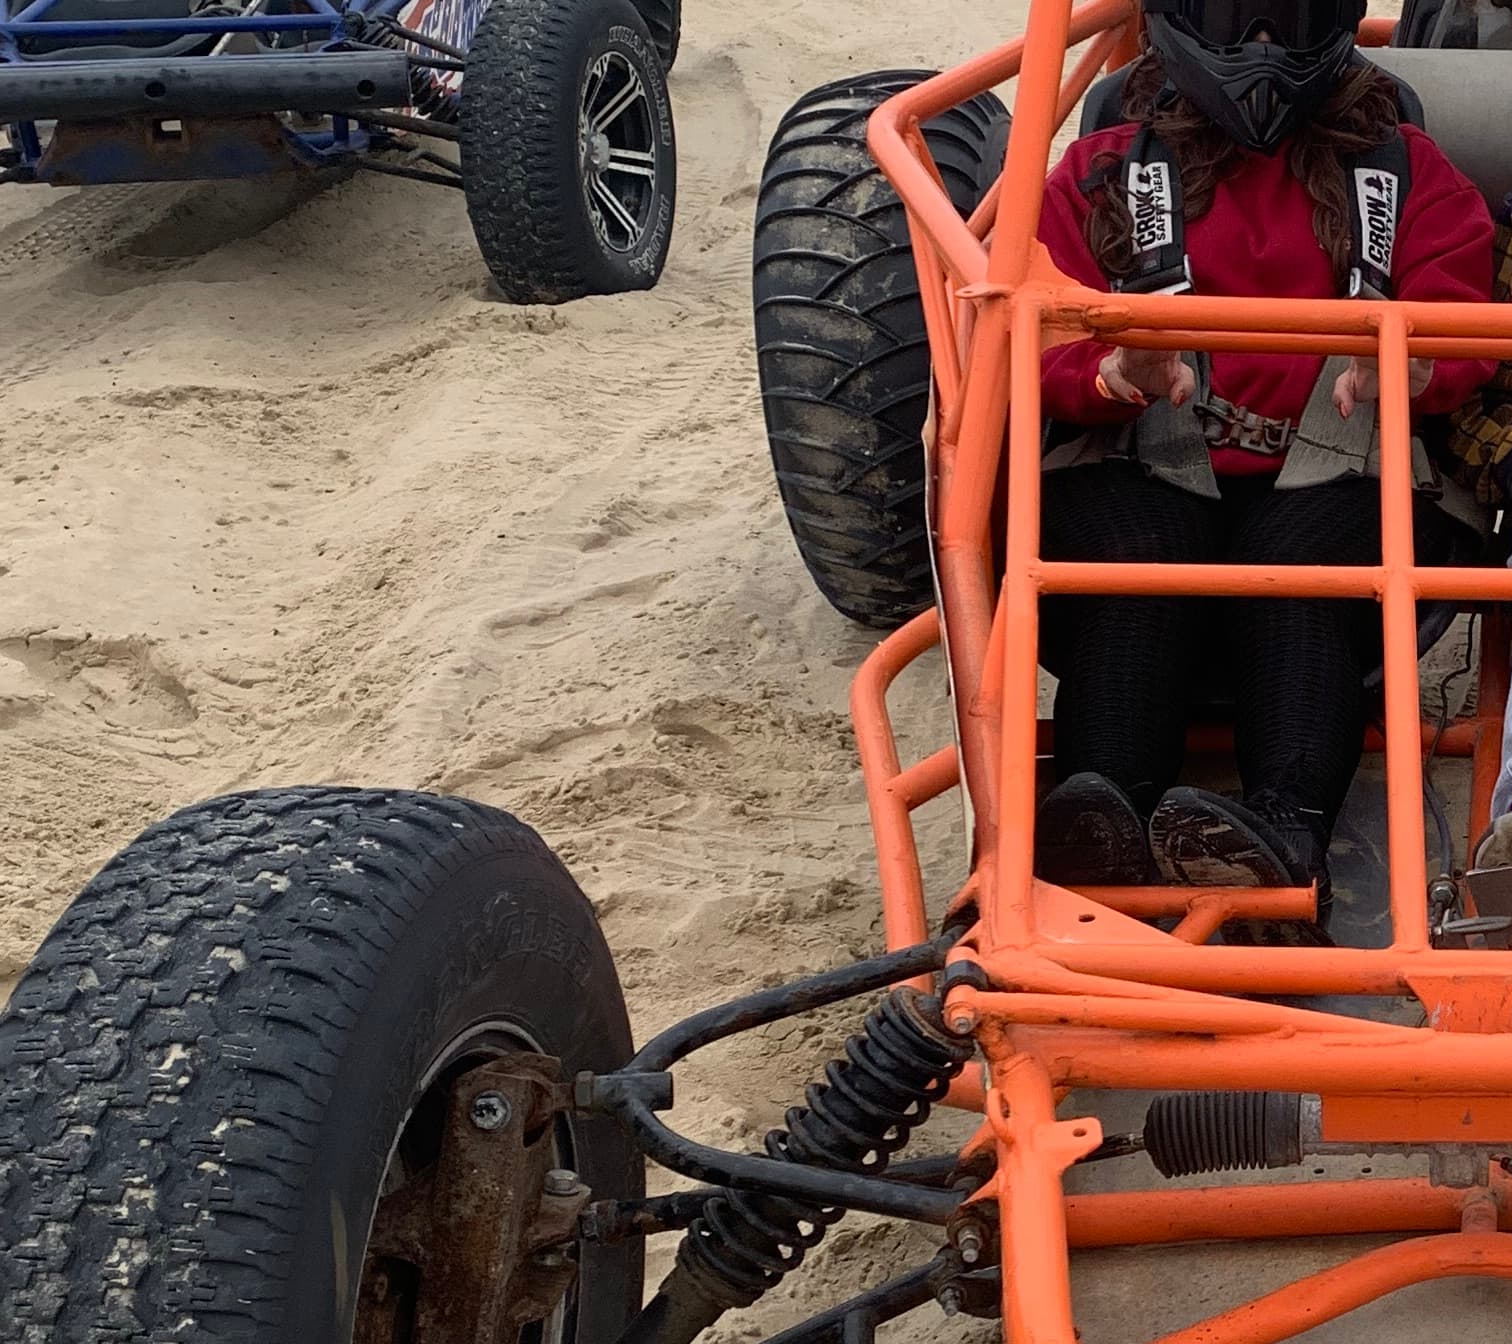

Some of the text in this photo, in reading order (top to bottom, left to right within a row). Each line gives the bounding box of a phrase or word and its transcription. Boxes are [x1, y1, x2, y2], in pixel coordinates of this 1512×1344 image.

[1135, 189, 1157, 249] CROW
[1151, 166, 1166, 241] SAFETY GEAR
[1366, 194, 1387, 265] CROW
[1382, 177, 1393, 269] SAFETY GEAR
